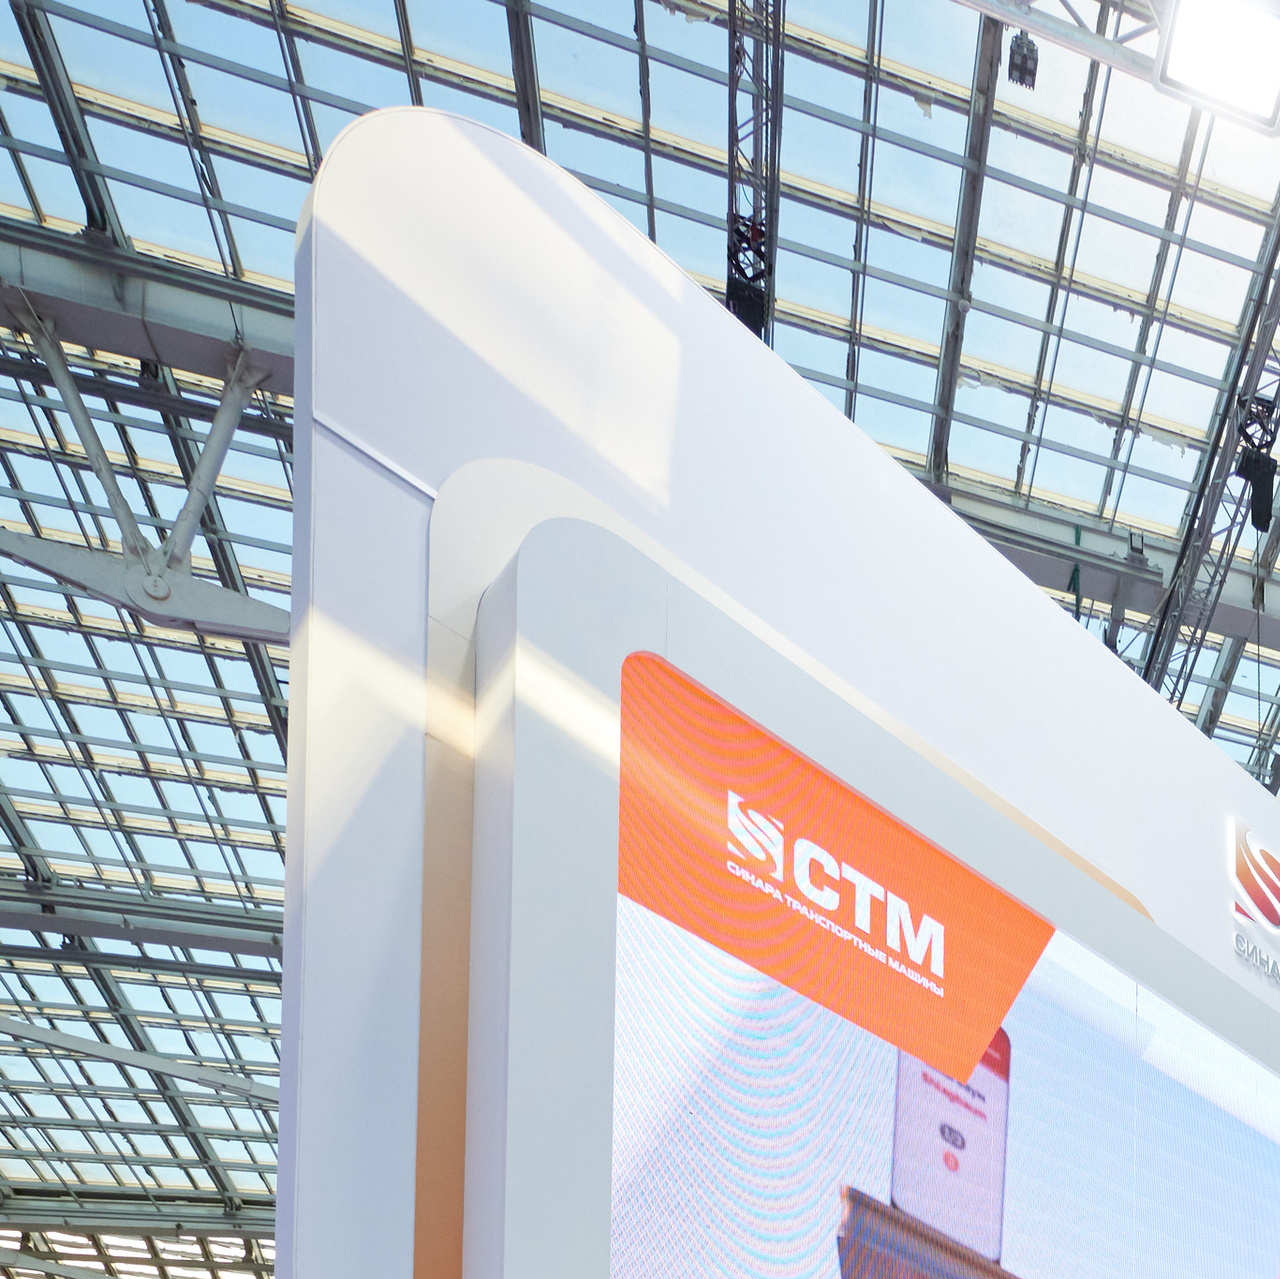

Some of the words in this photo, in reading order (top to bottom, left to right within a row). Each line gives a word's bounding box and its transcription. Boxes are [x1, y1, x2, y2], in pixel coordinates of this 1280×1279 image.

[726, 859, 784, 904] СИНАРА
[784, 893, 887, 965] ТРАНСПОРТНЫЕ
[888, 956, 945, 999] МАШИНЫ
[794, 838, 946, 980] СТМ
